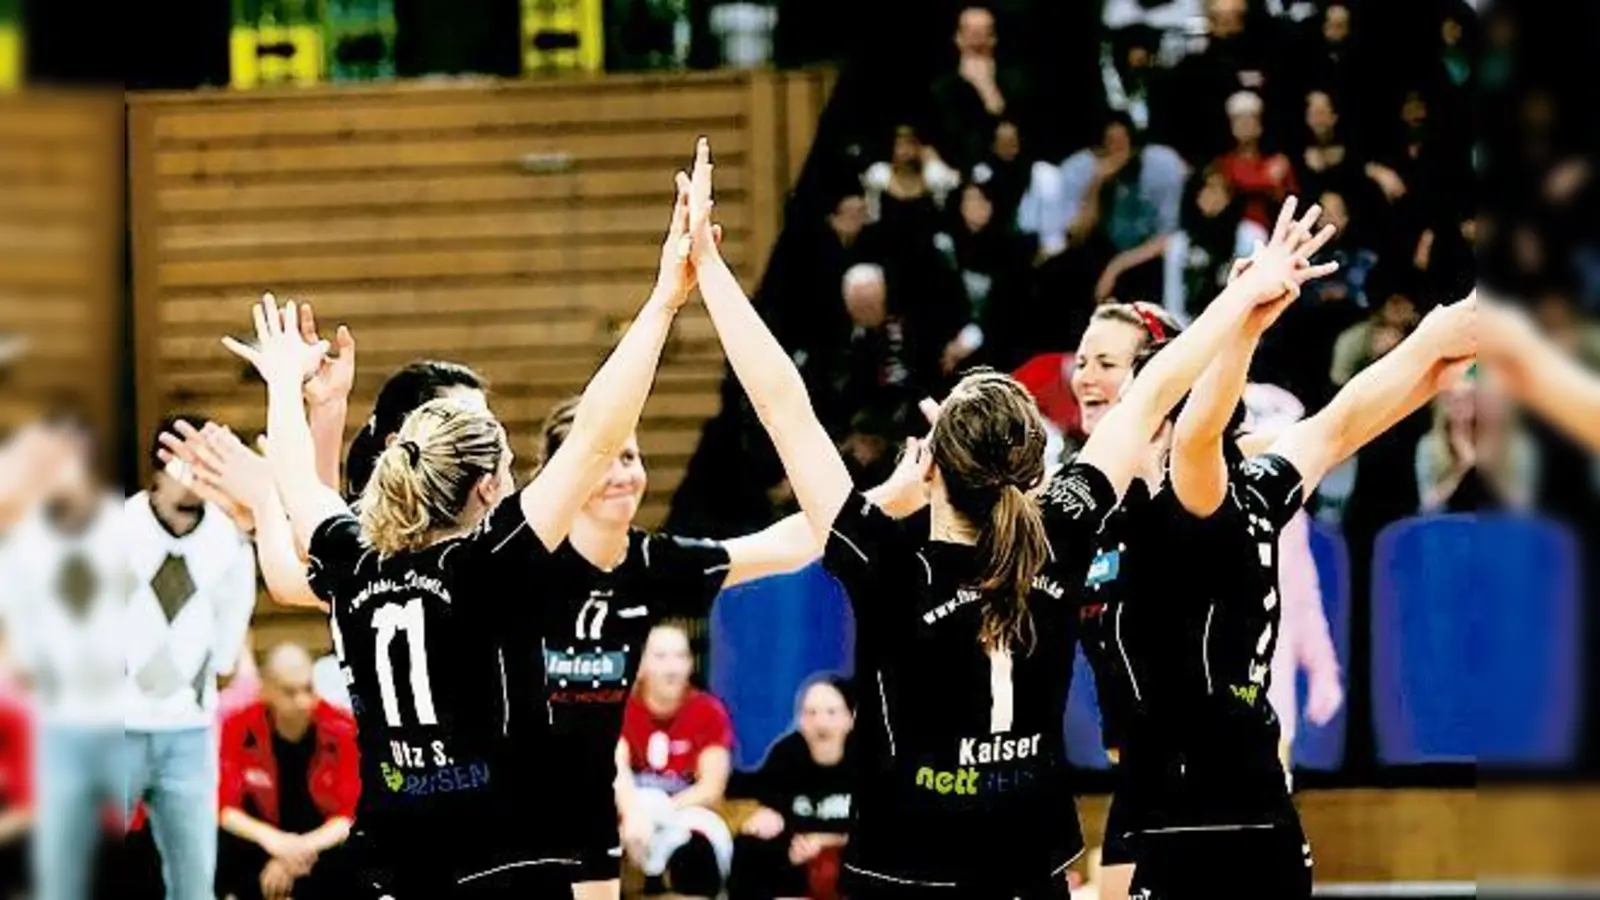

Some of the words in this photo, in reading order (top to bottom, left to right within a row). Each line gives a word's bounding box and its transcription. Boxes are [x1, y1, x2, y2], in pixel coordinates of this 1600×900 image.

[388, 739, 426, 769] Utz
[430, 739, 455, 767] S.
[958, 733, 1041, 767] Kaiser
[915, 766, 980, 795] nett
